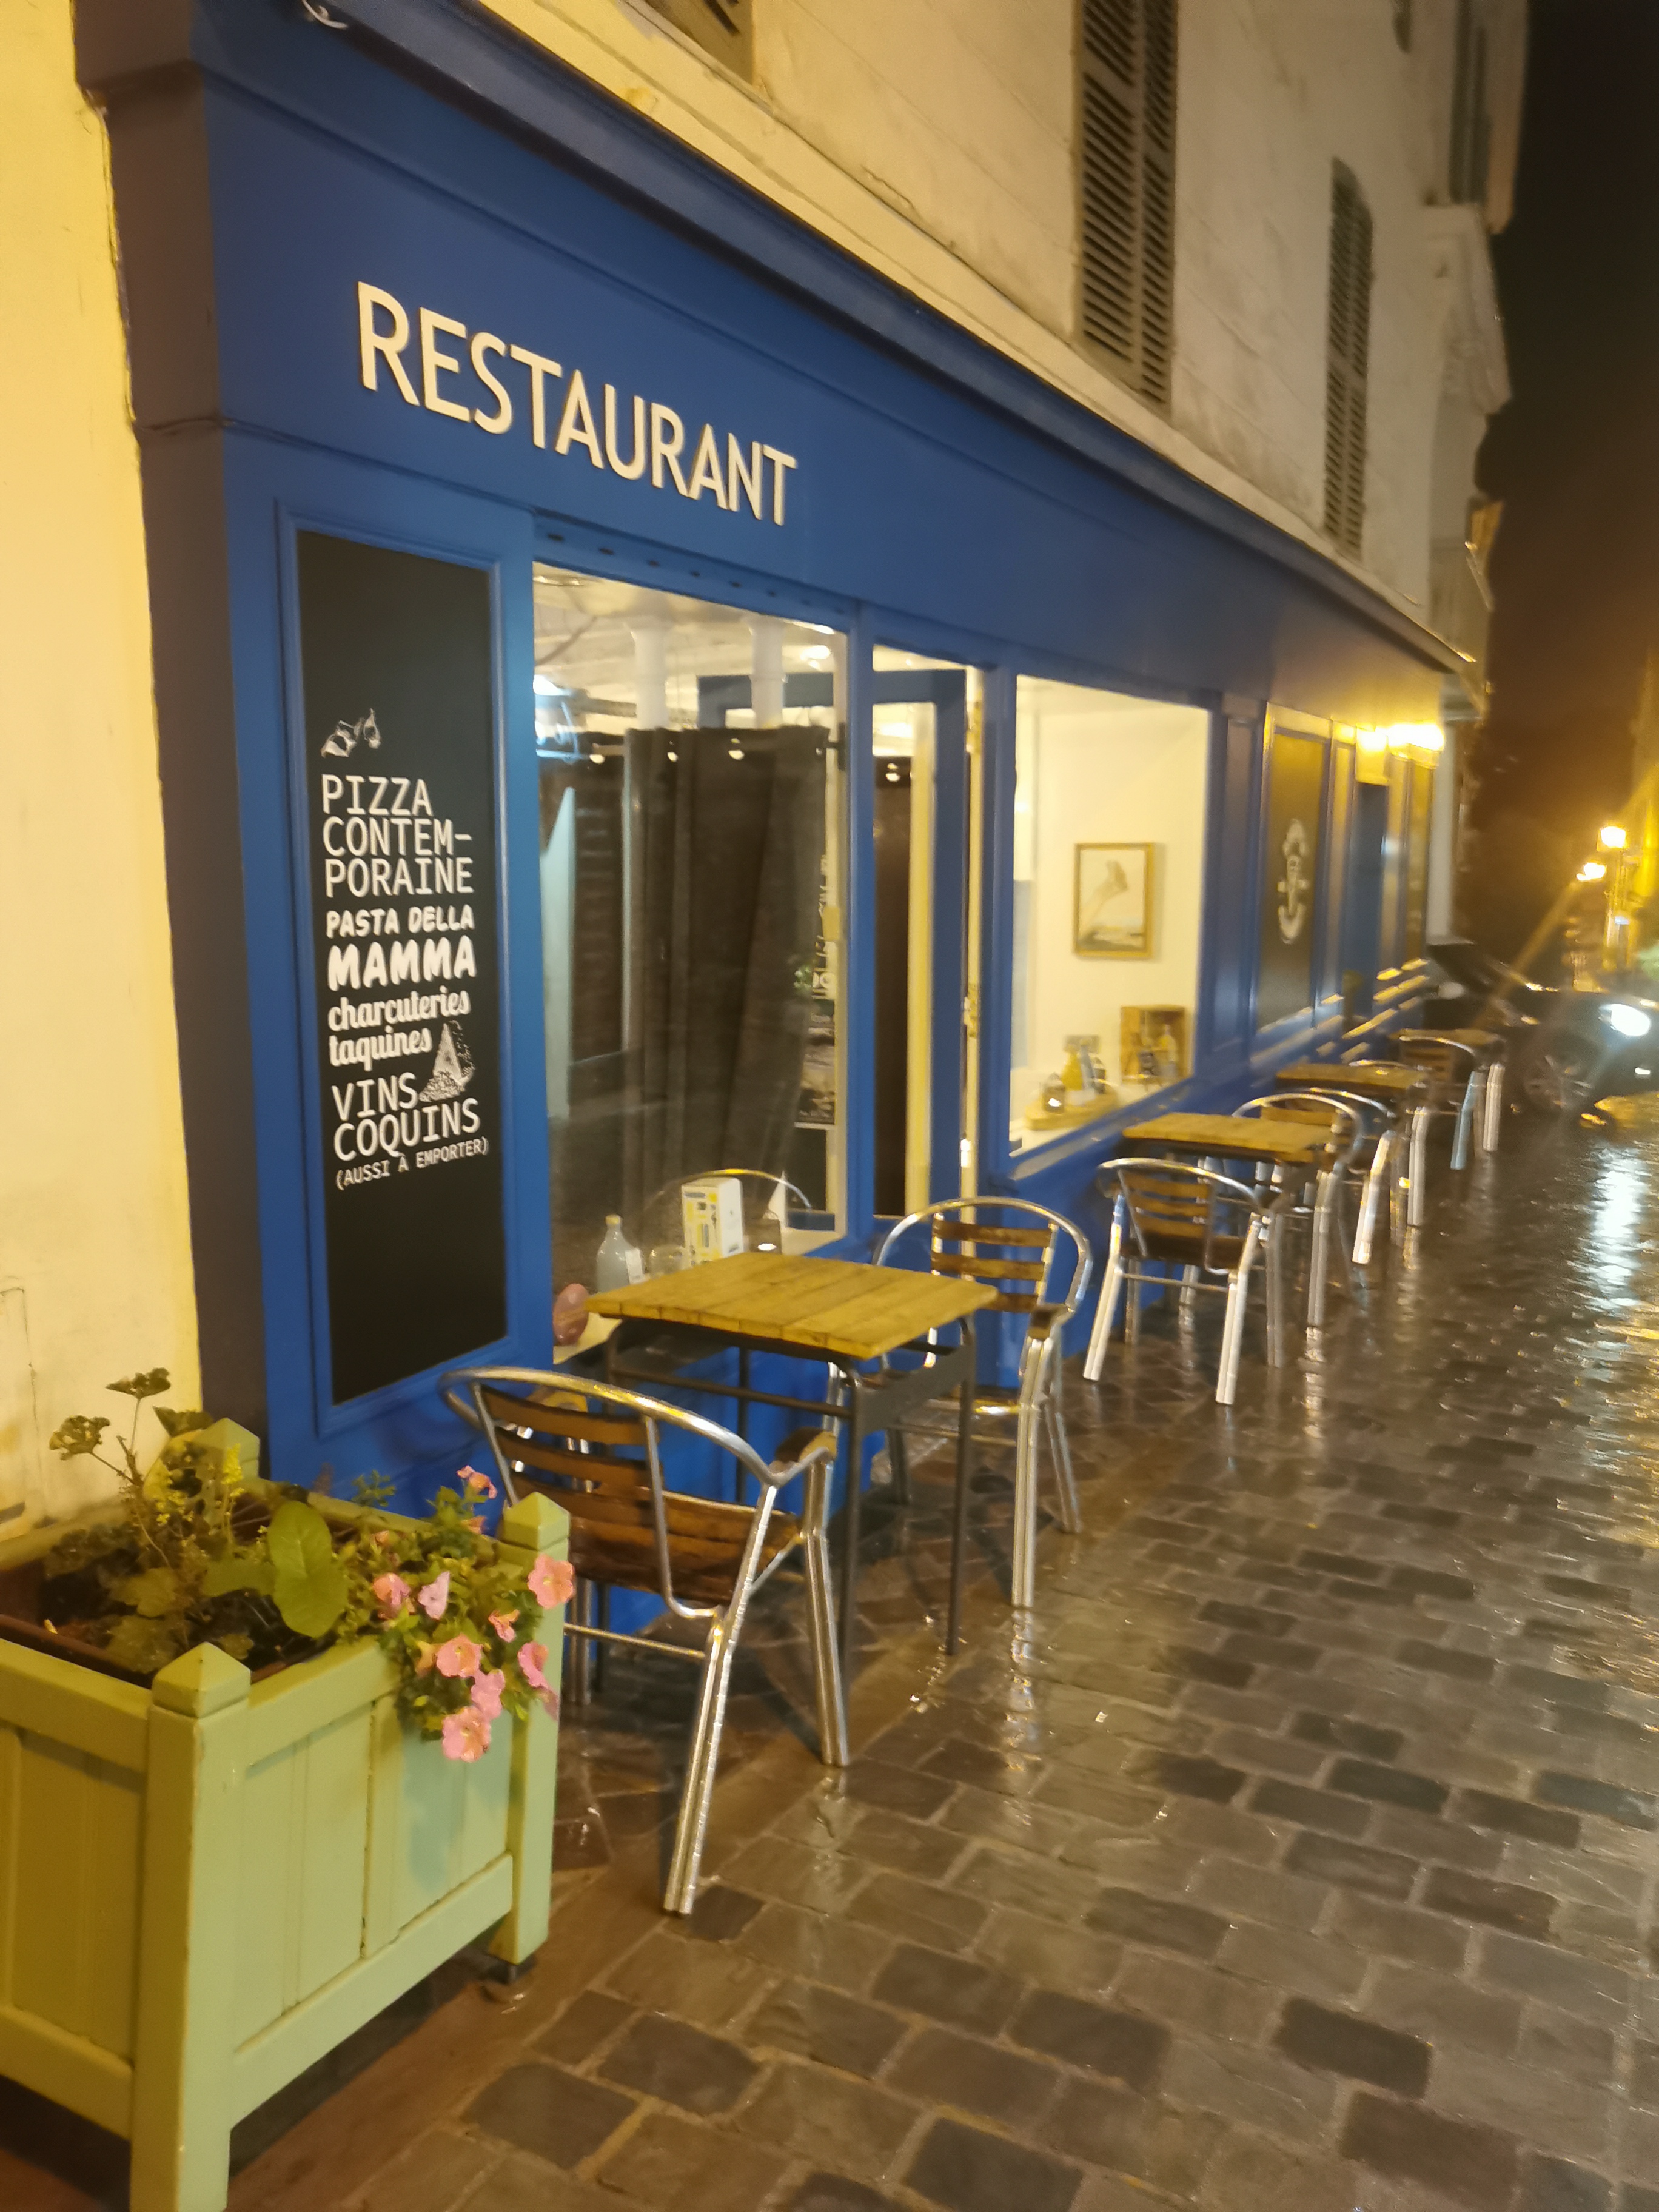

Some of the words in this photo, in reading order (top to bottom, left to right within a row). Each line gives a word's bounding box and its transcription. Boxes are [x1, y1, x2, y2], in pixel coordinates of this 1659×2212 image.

[357, 281, 798, 526] RESTAURANT
[321, 774, 434, 817] PIZZA
[323, 816, 473, 857] CONTEM-
[324, 857, 475, 898] PORAINE
[326, 908, 400, 938] PASTA
[407, 903, 475, 933] DELLA
[328, 935, 477, 991] MAMMA
[327, 985, 471, 1031] charcuteries
[329, 1025, 433, 1072] taquines
[332, 1072, 419, 1122] VINS
[333, 1098, 481, 1161] COQUINS
[336, 1160, 391, 1191] (AUSSI
[415, 1136, 489, 1168] EMPORTER)
